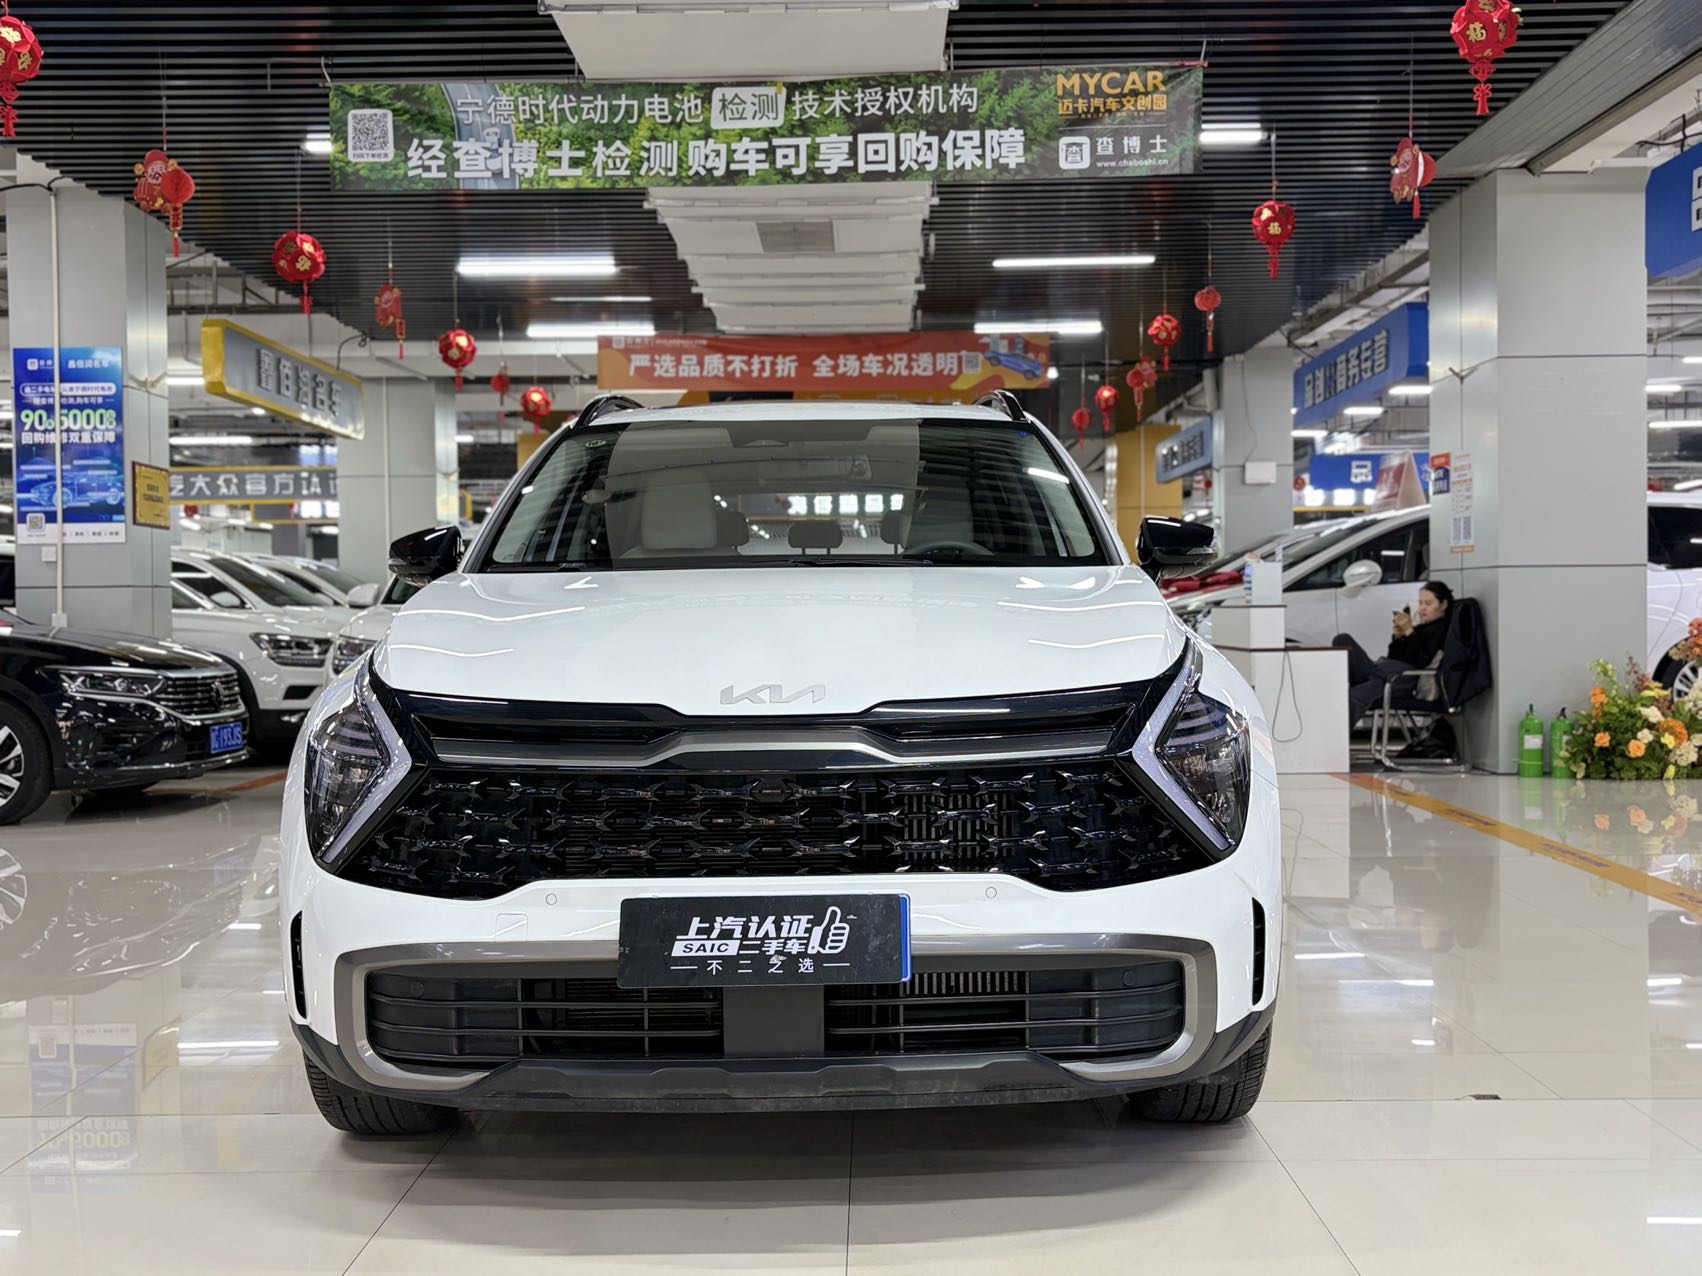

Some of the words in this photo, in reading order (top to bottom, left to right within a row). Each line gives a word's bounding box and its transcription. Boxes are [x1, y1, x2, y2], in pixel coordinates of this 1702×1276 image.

[1056, 71, 1166, 96] MYCAR
[456, 94, 703, 126] 宁德时代动力电池
[718, 90, 779, 122] 检测
[791, 83, 978, 121] 技术授权机构
[1058, 94, 1168, 115] 迈卡汽车文创园
[407, 127, 1026, 180] 经查博士检测购车可享回购保障
[1096, 134, 1168, 155] 查博士
[1096, 157, 1169, 168] www.chaboshi.cn
[629, 352, 799, 378] 严选品质不打折
[812, 352, 958, 378] 全场车况透明
[720, 684, 825, 705] KIA
[676, 914, 815, 940] 上汽认证
[682, 942, 730, 954] SAIC
[739, 938, 809, 955] 二手车
[706, 957, 815, 976] 不二之选
